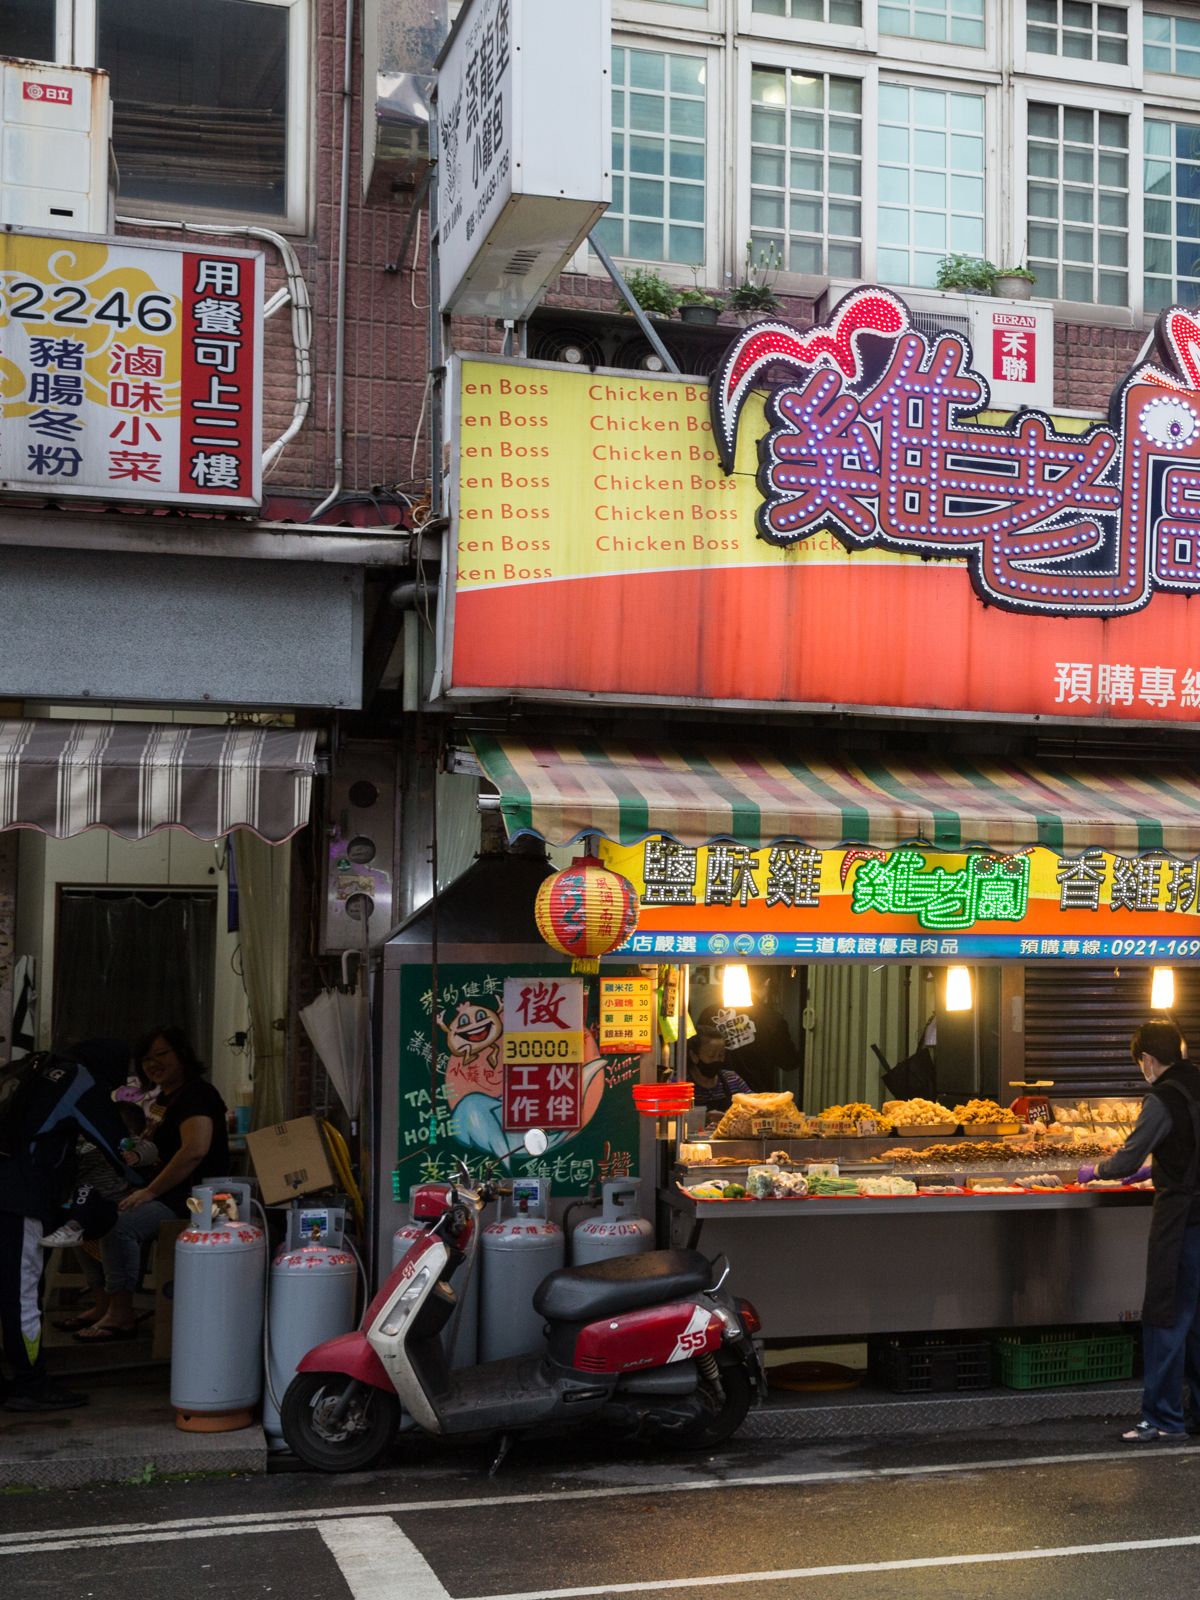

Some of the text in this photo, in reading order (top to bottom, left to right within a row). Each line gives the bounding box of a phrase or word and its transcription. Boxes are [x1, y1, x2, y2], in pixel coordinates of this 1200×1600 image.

[45, 86, 72, 102] 日立
[0, 282, 173, 332] 2246
[993, 313, 1036, 328] HERAN
[1001, 331, 1029, 383] 禾聯
[190, 258, 243, 490] 用餐可上二樓
[500, 379, 549, 395] Boss
[588, 386, 679, 402] Chicken
[28, 337, 85, 478] 豬腸冬粉
[108, 344, 164, 483] 滷味小菜
[500, 411, 549, 427] Boss
[590, 415, 680, 432] Chicken
[500, 442, 549, 457] Boss
[592, 445, 681, 461] Chicken
[501, 472, 550, 488] Boss
[594, 475, 737, 491] Chicken Boss
[501, 504, 550, 519] Boss
[595, 505, 738, 521] Chicken Boss
[502, 536, 550, 552] Boss
[596, 535, 740, 551] Chicken Boss
[504, 563, 553, 580] Boss
[641, 841, 823, 908] 鹽酥雞
[794, 936, 959, 955] 三道驗證優良肉品
[516, 982, 573, 1030] 徵
[506, 1040, 569, 1058] 30000
[404, 1085, 459, 1107] TAKE
[419, 1106, 451, 1124] ME
[404, 1120, 462, 1146] HOME
[680, 1331, 705, 1351] 55
